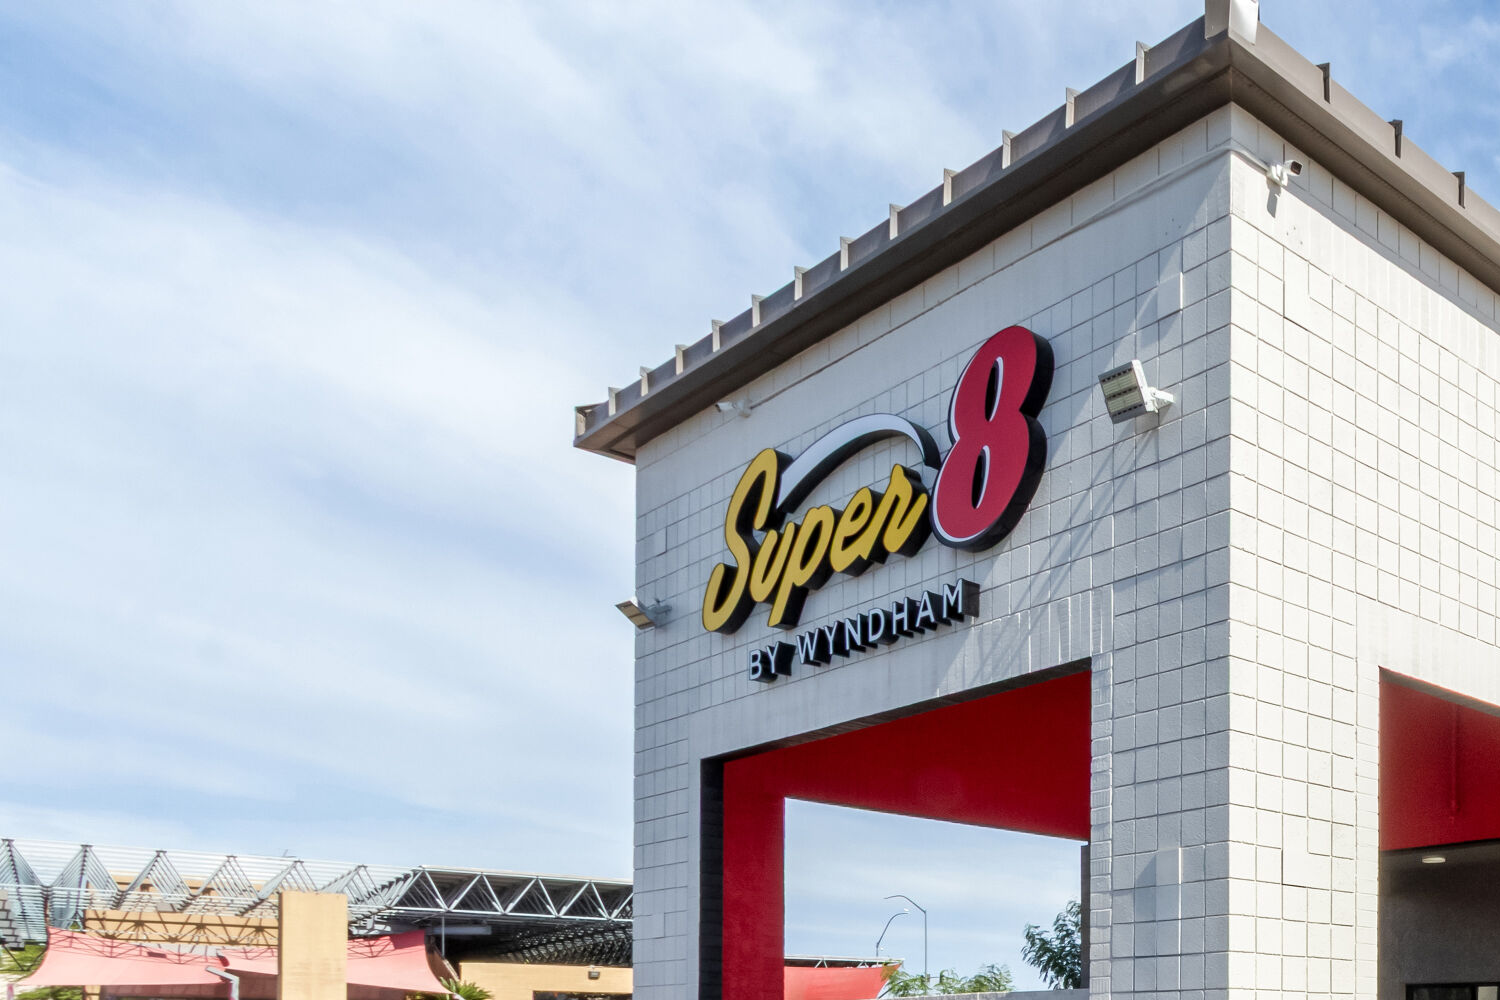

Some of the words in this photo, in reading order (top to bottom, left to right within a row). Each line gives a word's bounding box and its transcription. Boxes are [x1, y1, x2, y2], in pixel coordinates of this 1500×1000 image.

[703, 448, 928, 636] Super
[931, 325, 1053, 551] 8
[750, 641, 788, 681] BY
[797, 578, 975, 666] WYNDHAM
